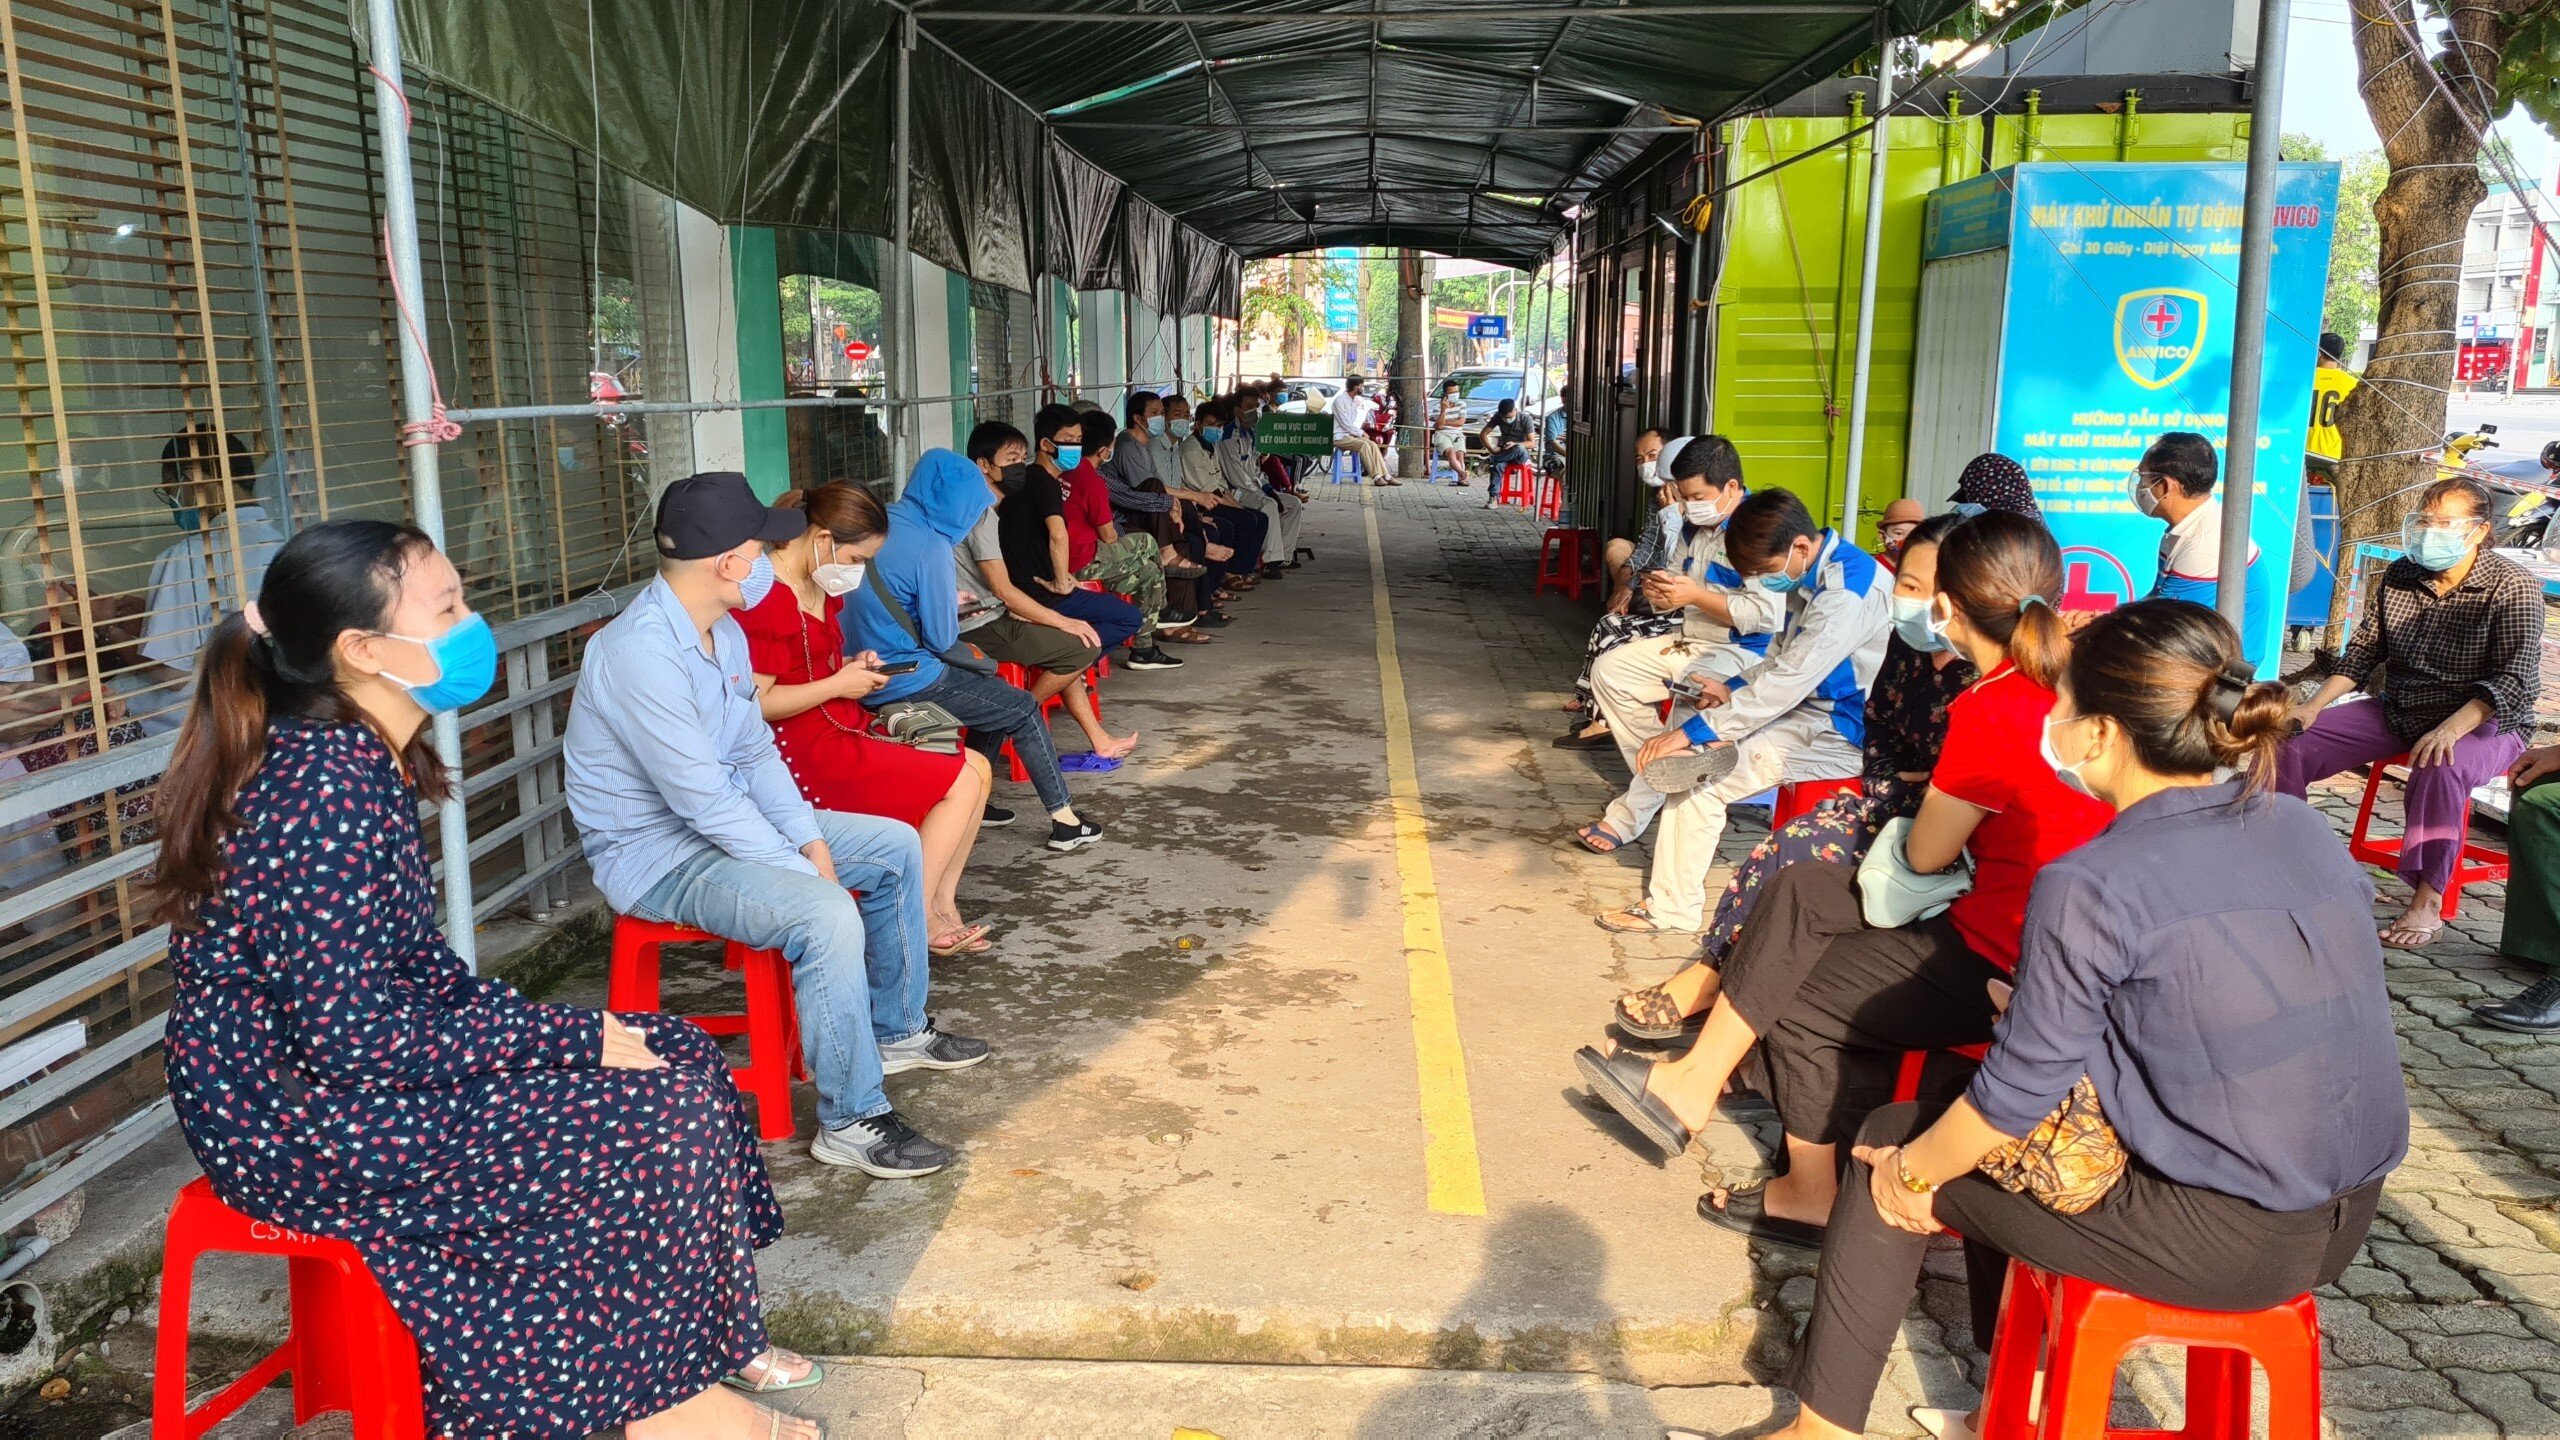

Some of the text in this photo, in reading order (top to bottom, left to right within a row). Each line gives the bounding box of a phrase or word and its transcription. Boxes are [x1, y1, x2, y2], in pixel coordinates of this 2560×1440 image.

[2030, 201, 2068, 228] MÁY
[2112, 196, 2171, 228] KHUẨN
[2176, 204, 2200, 232] TỰ
[2084, 241, 2101, 254] 30
[2126, 345, 2190, 360] ANVICO
[1273, 422, 1287, 431] KHU
[1288, 422, 1302, 432] VỰC
